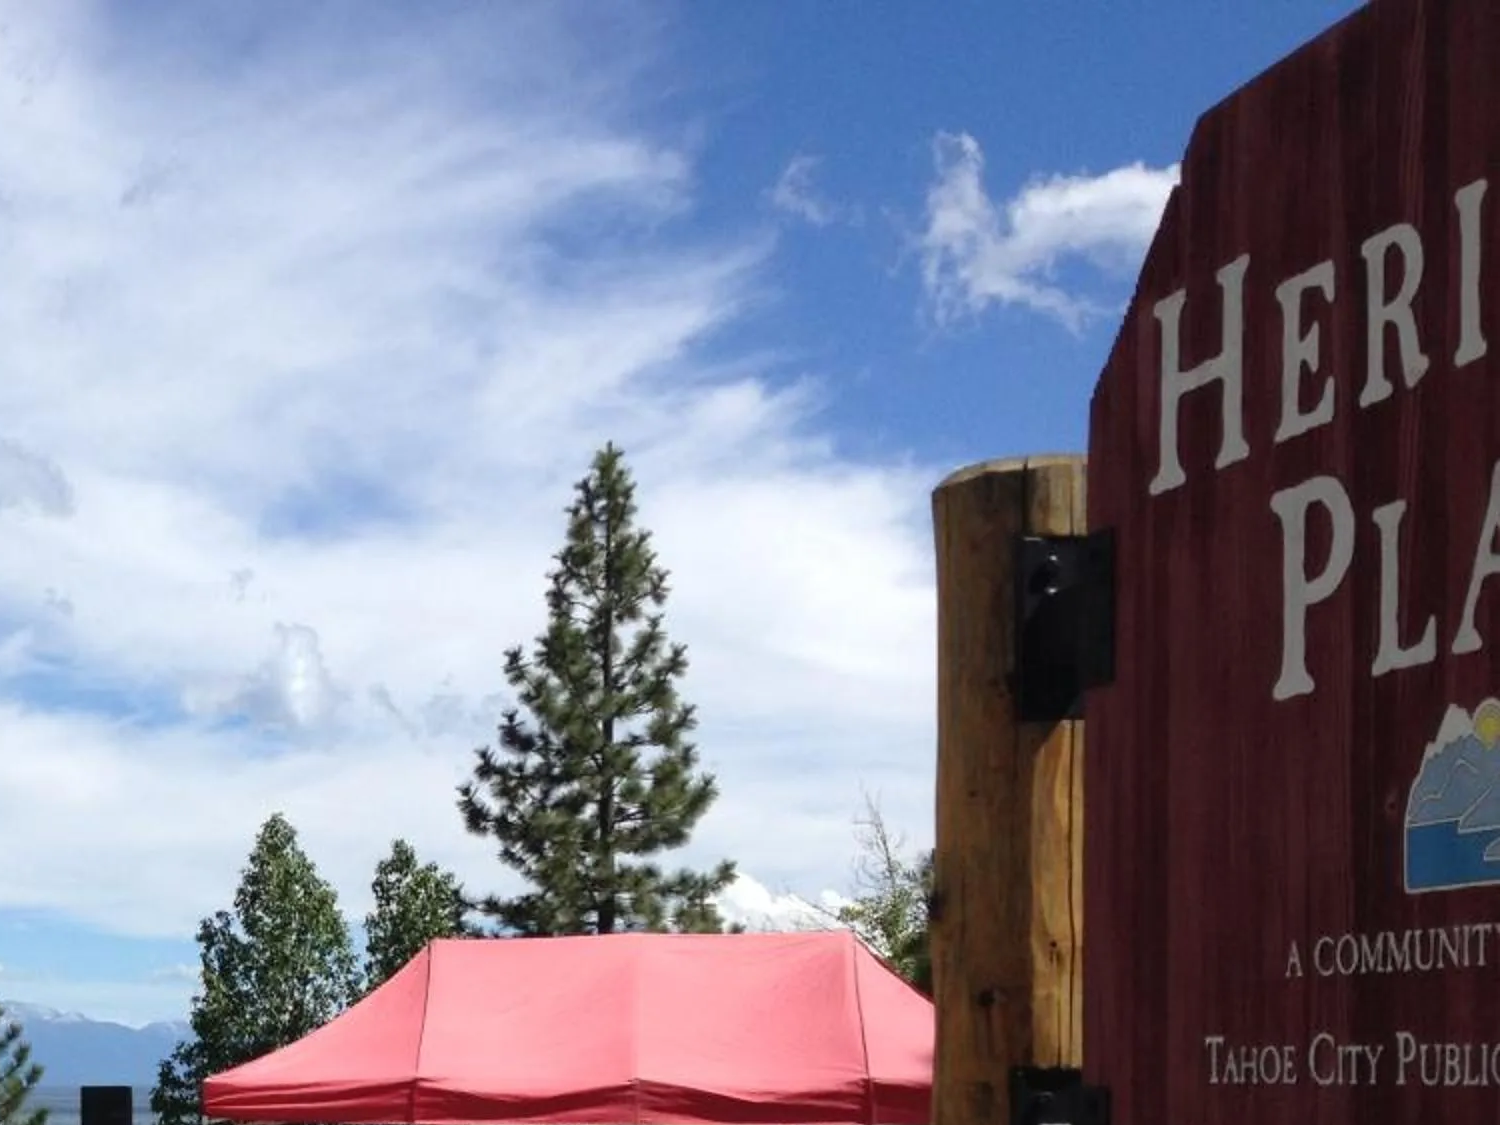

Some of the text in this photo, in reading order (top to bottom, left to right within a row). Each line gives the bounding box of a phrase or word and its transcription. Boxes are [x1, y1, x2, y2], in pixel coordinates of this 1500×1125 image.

[1149, 178, 1488, 496] HERI
[1285, 923, 1500, 979] A COMMUNIT
[1308, 1031, 1384, 1087] CITY
